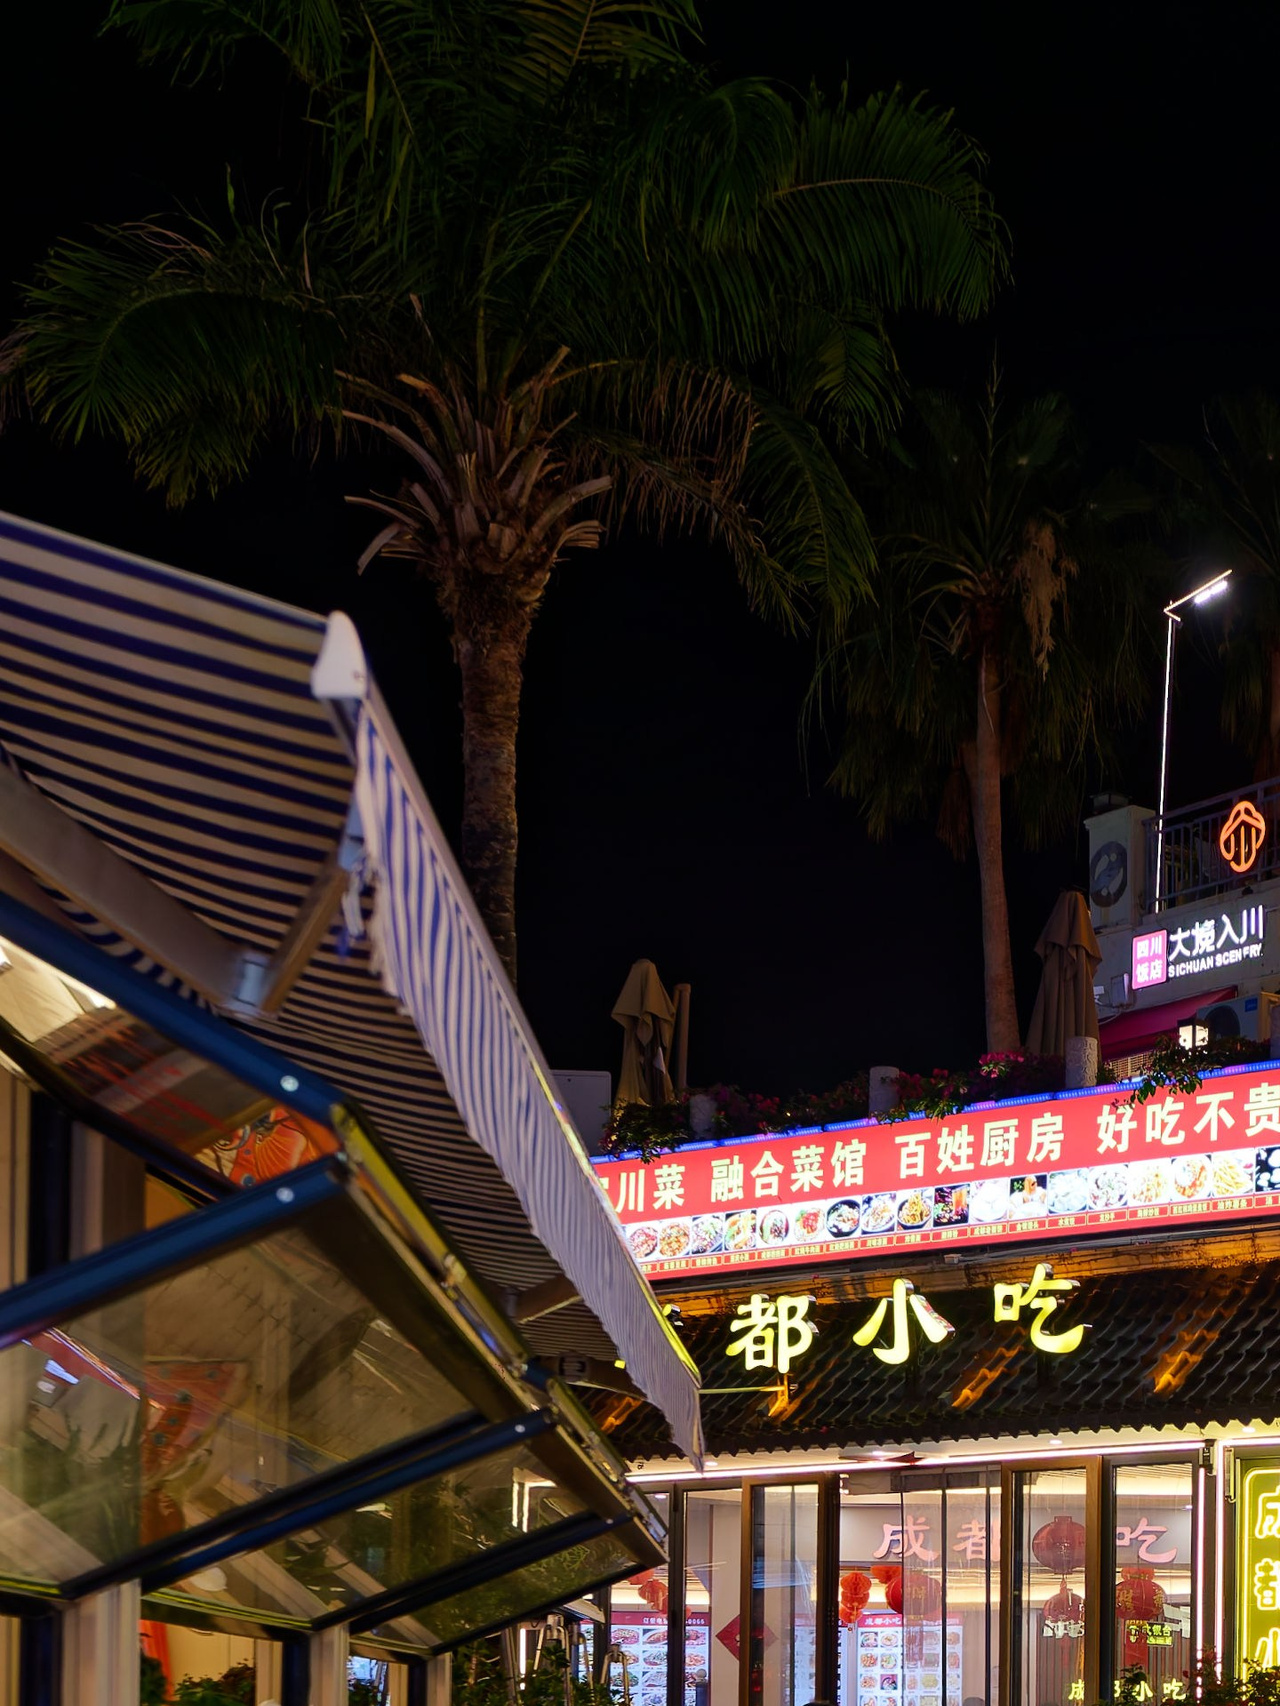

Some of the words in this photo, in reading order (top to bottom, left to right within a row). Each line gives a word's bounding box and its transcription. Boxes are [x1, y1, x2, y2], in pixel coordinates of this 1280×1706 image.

[1136, 934, 1163, 960] 四川
[1135, 959, 1164, 984] 饭店
[1167, 955, 1214, 978] SICHUAN
[710, 1138, 868, 1204] 融合菜馆
[893, 1111, 1067, 1181] 百姓厨房
[724, 1262, 1086, 1375] 都小吃
[872, 1515, 1178, 1563] 成都吃
